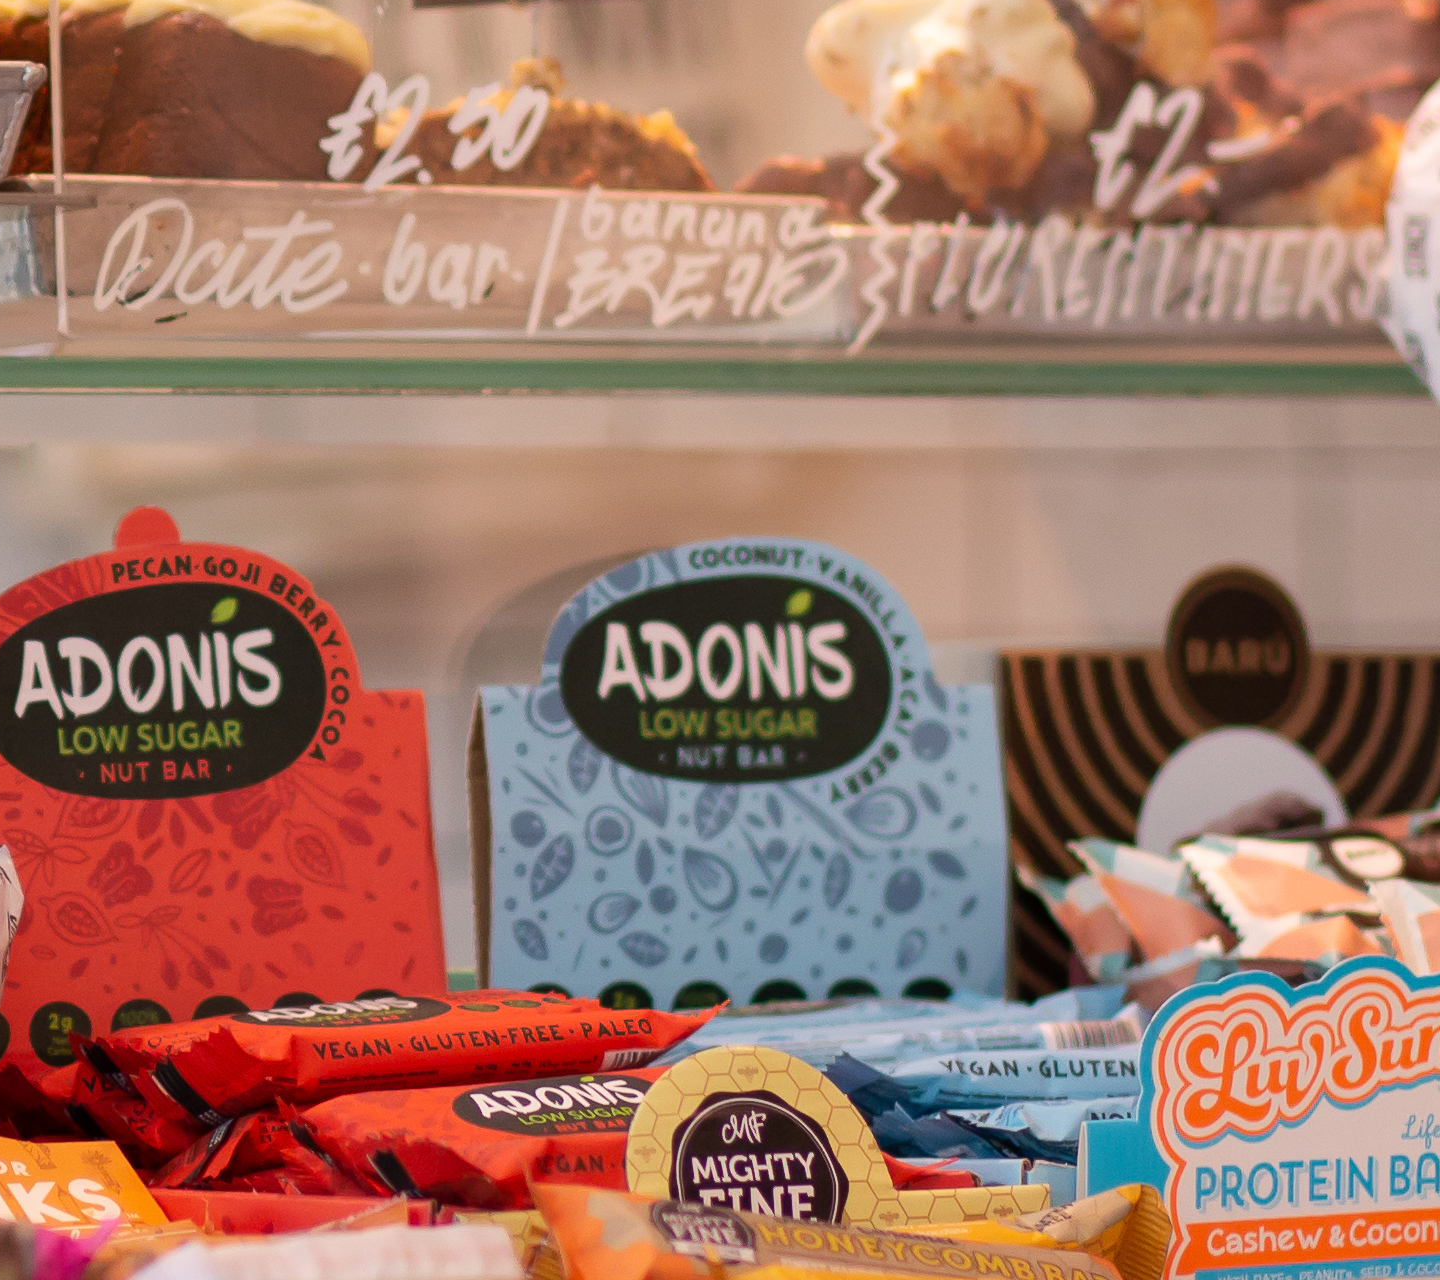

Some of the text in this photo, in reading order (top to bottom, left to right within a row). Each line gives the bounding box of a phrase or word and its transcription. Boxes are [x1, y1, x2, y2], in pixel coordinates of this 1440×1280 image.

[320, 73, 551, 192] £2.50
[579, 186, 823, 246] banana
[94, 197, 348, 313] Date
[15, 628, 282, 720] ADONIS
[598, 621, 855, 703] ADONIS
[58, 720, 243, 756] LOW SUGAR
[639, 707, 817, 738] LOW SUGAR
[100, 759, 211, 783] NUT BAR
[676, 745, 787, 768] NUT BAR
[314, 1018, 653, 1060] VEGAN GLUTEN-FREE PALEO
[939, 1059, 1019, 1077] VEGAN
[470, 1078, 646, 1118] ADONIS
[518, 1106, 634, 1127] LOW SUGAR
[692, 1152, 815, 1184] MIGHTY
[1195, 1153, 1375, 1209] PROTEIN
[1207, 1226, 1323, 1257] Cashew
[1329, 1224, 1345, 1247] &
